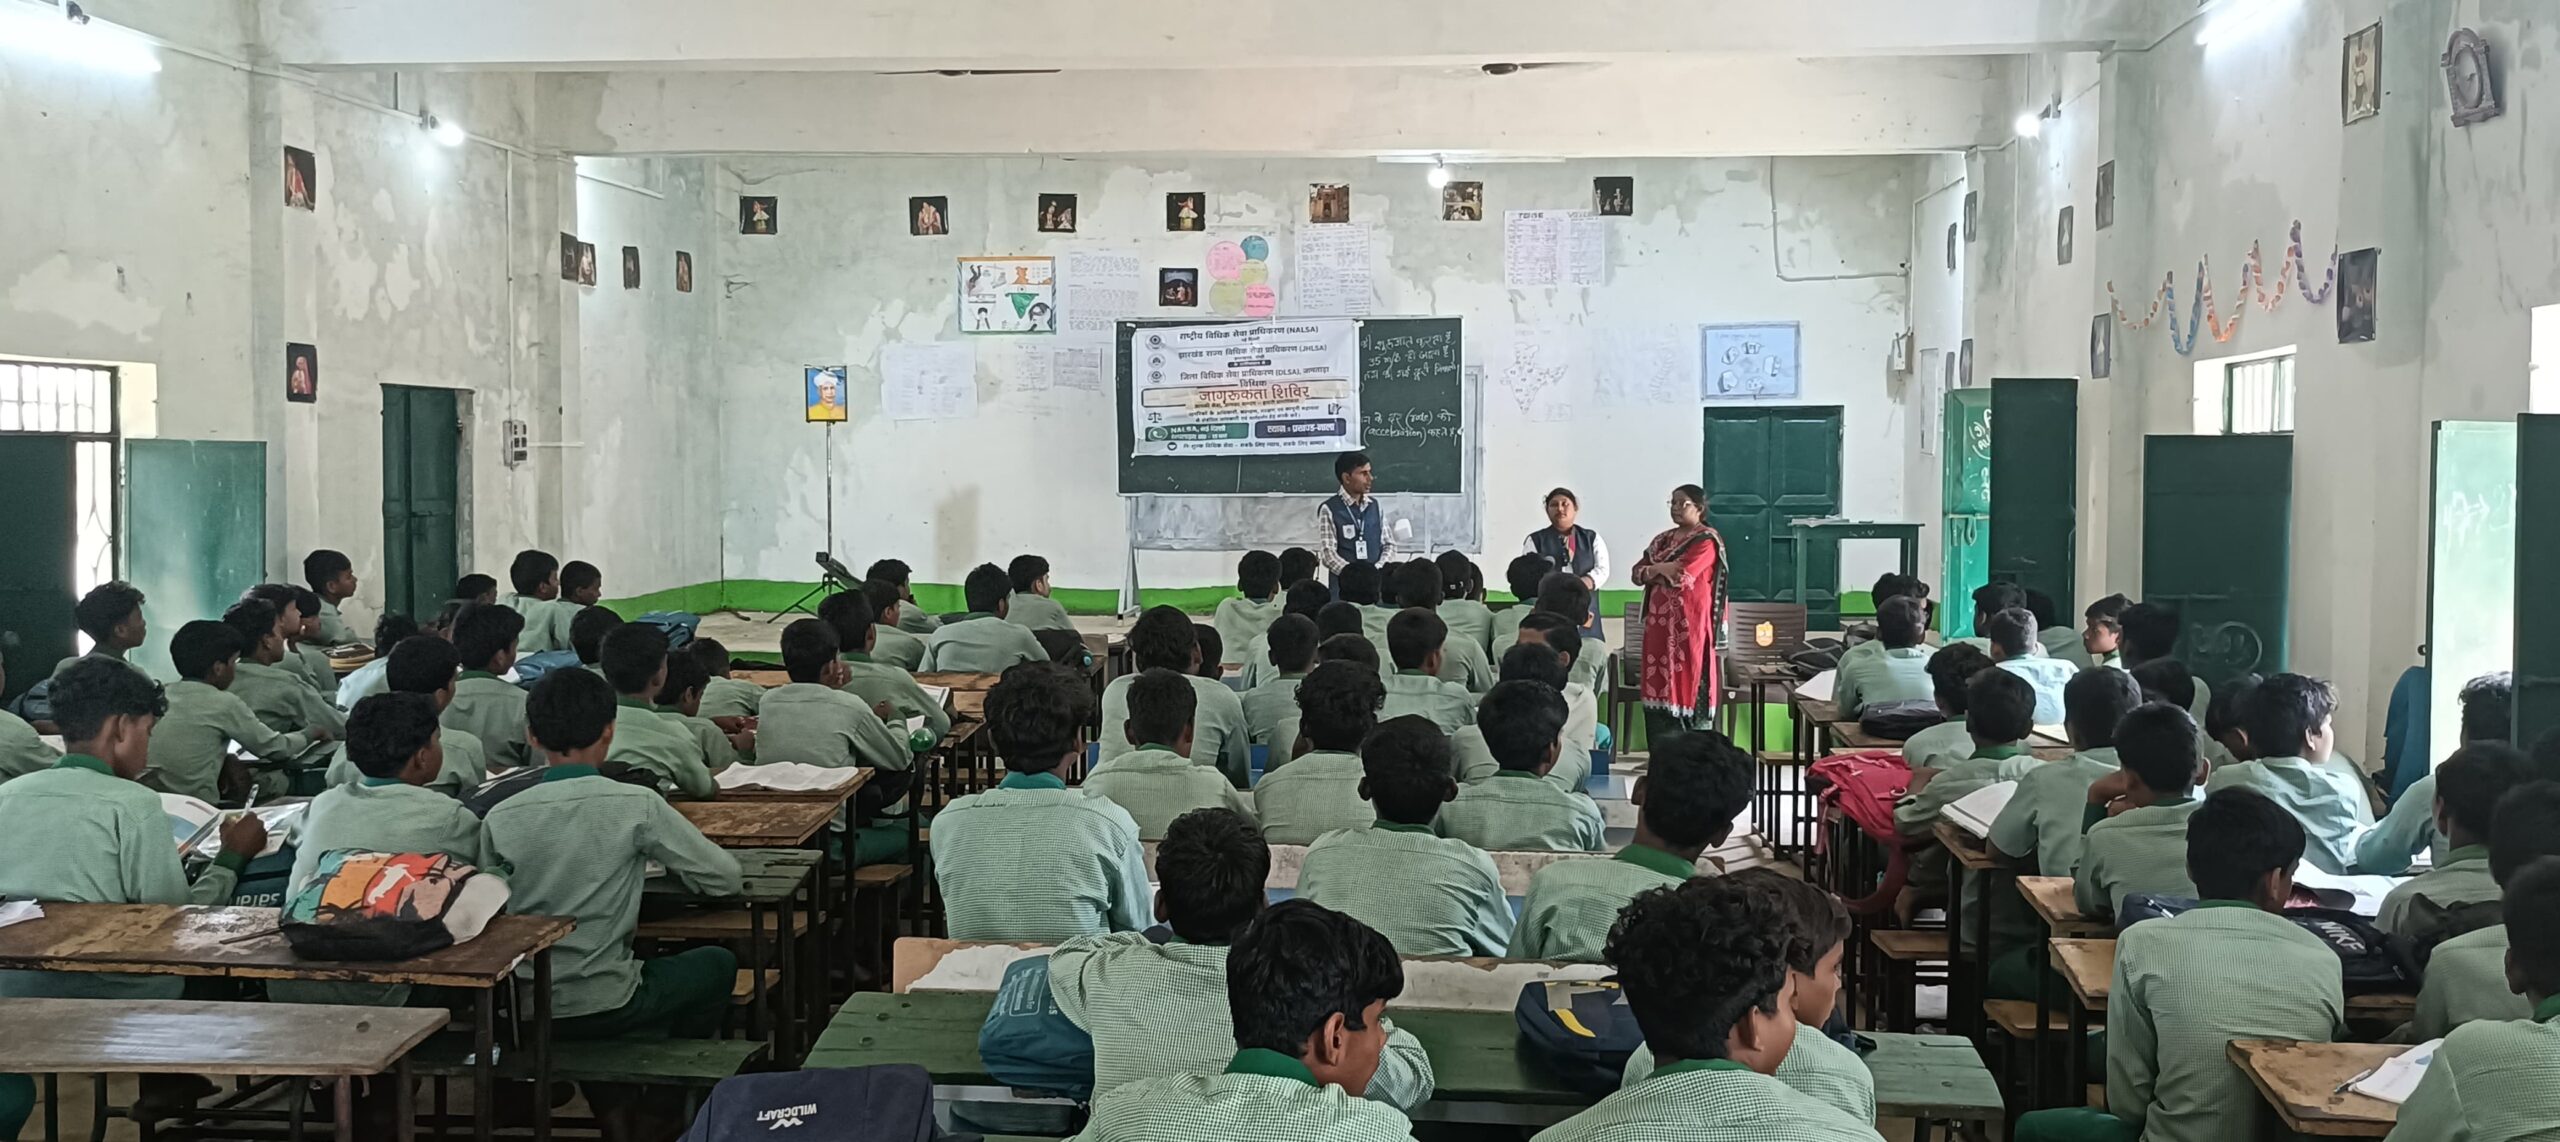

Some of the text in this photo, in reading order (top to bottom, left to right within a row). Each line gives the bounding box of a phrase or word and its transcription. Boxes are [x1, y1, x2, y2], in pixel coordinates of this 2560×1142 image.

[1179, 326, 1318, 341] राष्ट्रीय विधिक सेवा प्राधिकरण (NALSA)
[1178, 350, 1203, 360] झारखंड
[1225, 347, 1248, 356] विधिक
[1249, 346, 1263, 354] सेवा
[1265, 344, 1298, 353] प्राधिकरण
[1299, 344, 1327, 352] (JHLSA)
[1368, 356, 1381, 367] 35
[1180, 371, 1198, 380] जिला
[1200, 370, 1223, 379] विधिक
[1225, 369, 1239, 378] सेवा
[1241, 368, 1274, 377] प्राधिकरण
[1240, 378, 1267, 388] विधिक
[1272, 383, 1310, 399] शिविर
[756, 1103, 818, 1122] WILDCRAFT
